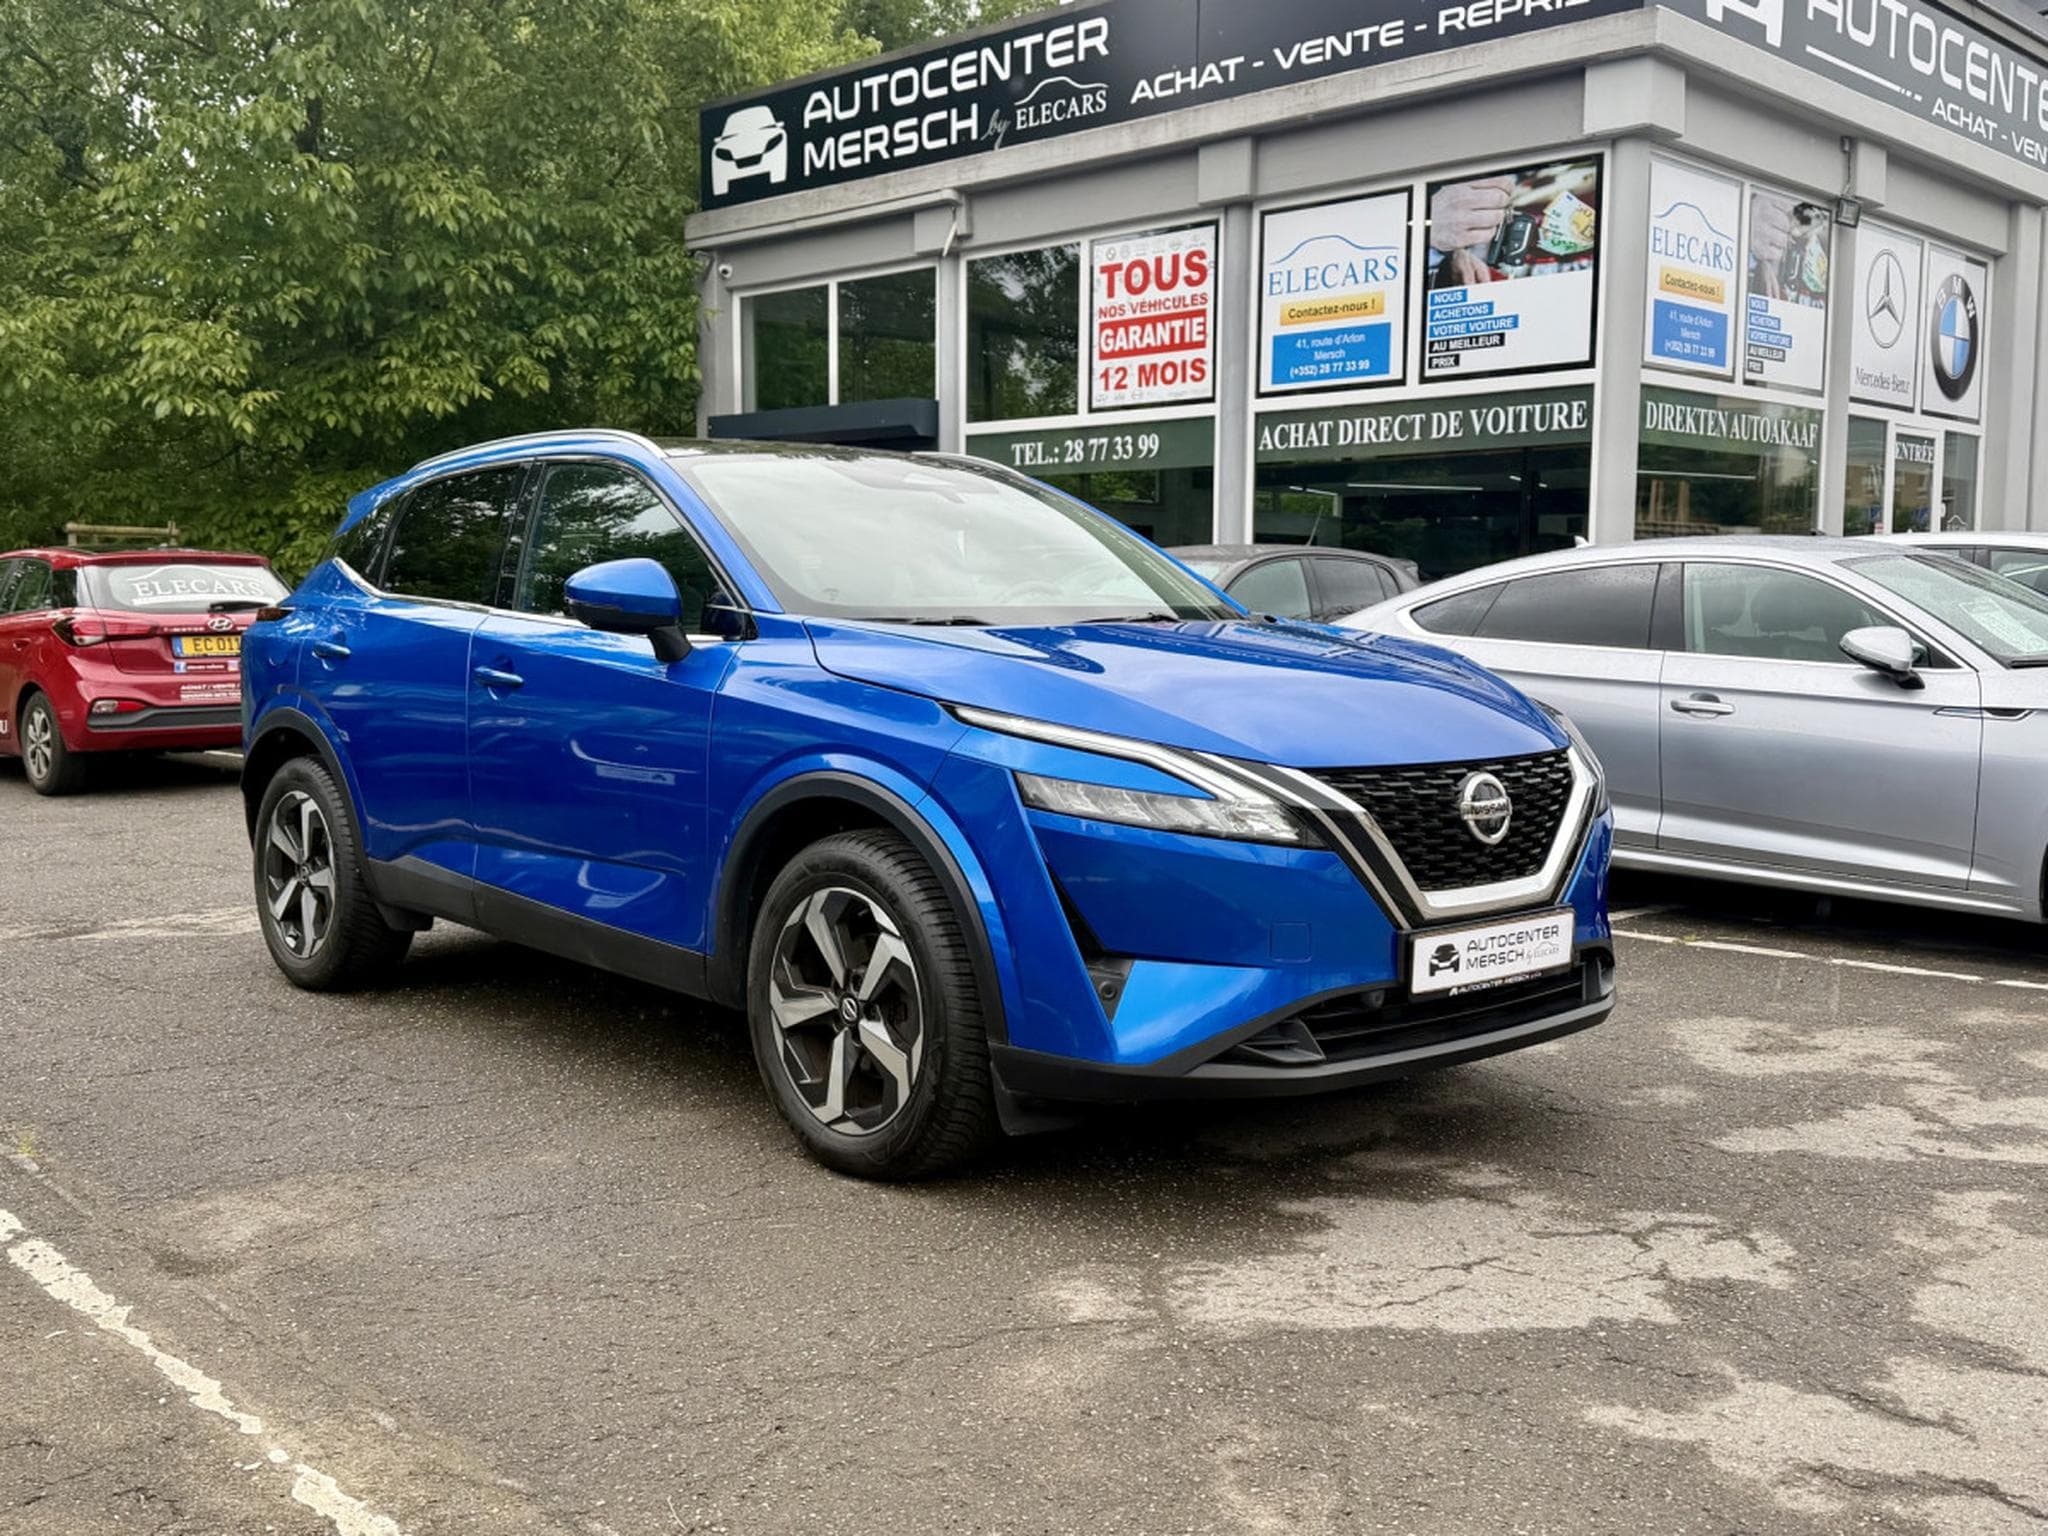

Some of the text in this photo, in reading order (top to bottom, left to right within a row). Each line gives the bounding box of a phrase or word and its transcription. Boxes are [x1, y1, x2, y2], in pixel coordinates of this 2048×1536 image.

[804, 17, 1108, 128] AUTOCENTER
[1131, 56, 1245, 103] ACHAT
[1272, 20, 1404, 70] VENTE
[804, 90, 1107, 176] MERSCH by ELECARS
[1932, 97, 1998, 140] ACHAT
[1652, 226, 1734, 272] ELECARS
[1100, 250, 1208, 298] TOUS
[1269, 255, 1399, 296] ELECARS
[1098, 304, 1126, 318] NOS
[1288, 302, 1369, 319] Contactez-nous
[1432, 304, 1489, 320] ACHETONS
[1433, 291, 1463, 304] NOUS
[1101, 317, 1205, 353] GARANTIE
[1432, 317, 1514, 336] VOTRE VOITURE
[1432, 335, 1500, 352] AU MEILLEUR
[1100, 358, 1207, 391] 12 MOIS
[1431, 356, 1455, 368] PRIX
[1258, 400, 1588, 451] ACHAT DIRECT DE VOITURE
[1645, 401, 1819, 449] DIREKTEN AUTOAKAAF
[1011, 433, 1160, 466] TEL.: 28 77 33 99
[1895, 439, 1935, 465] ENTRÉE
[133, 579, 264, 597] ELECARS
[193, 637, 213, 652] EC
[1466, 924, 1559, 953] AUTOCENTER
[1465, 949, 1524, 970] MERSCH
